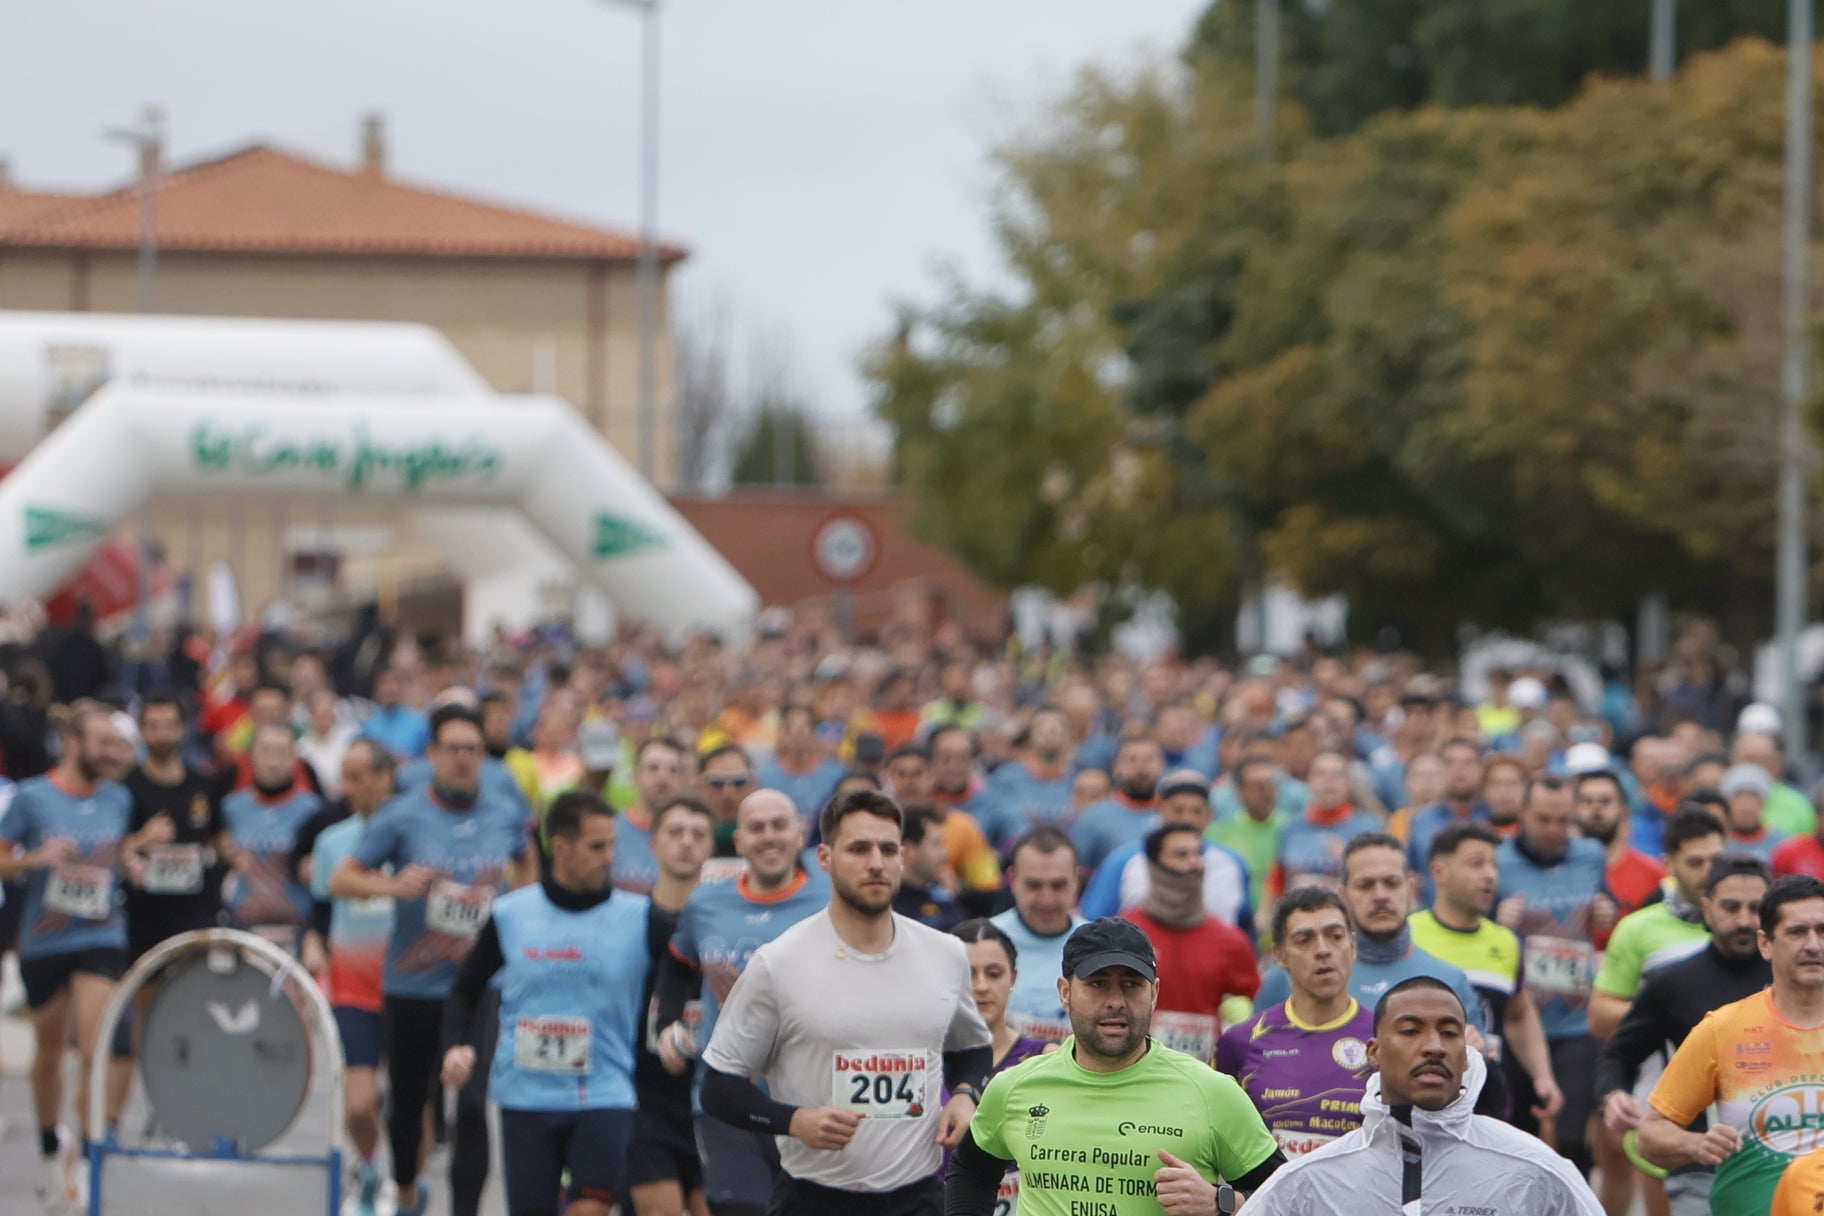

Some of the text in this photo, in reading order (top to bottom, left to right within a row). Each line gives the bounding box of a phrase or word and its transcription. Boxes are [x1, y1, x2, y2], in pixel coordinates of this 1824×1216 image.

[835, 1054, 926, 1072] bedunia
[850, 1073, 914, 1104] 204
[1261, 1087, 1300, 1099] Jamón
[1751, 1079, 1783, 1103] CLUB
[1138, 1123, 1184, 1138] enusa
[1030, 1144, 1150, 1168] Carrera Popular
[1095, 1176, 1114, 1194] DE
[1458, 1206, 1498, 1216] TERREX
